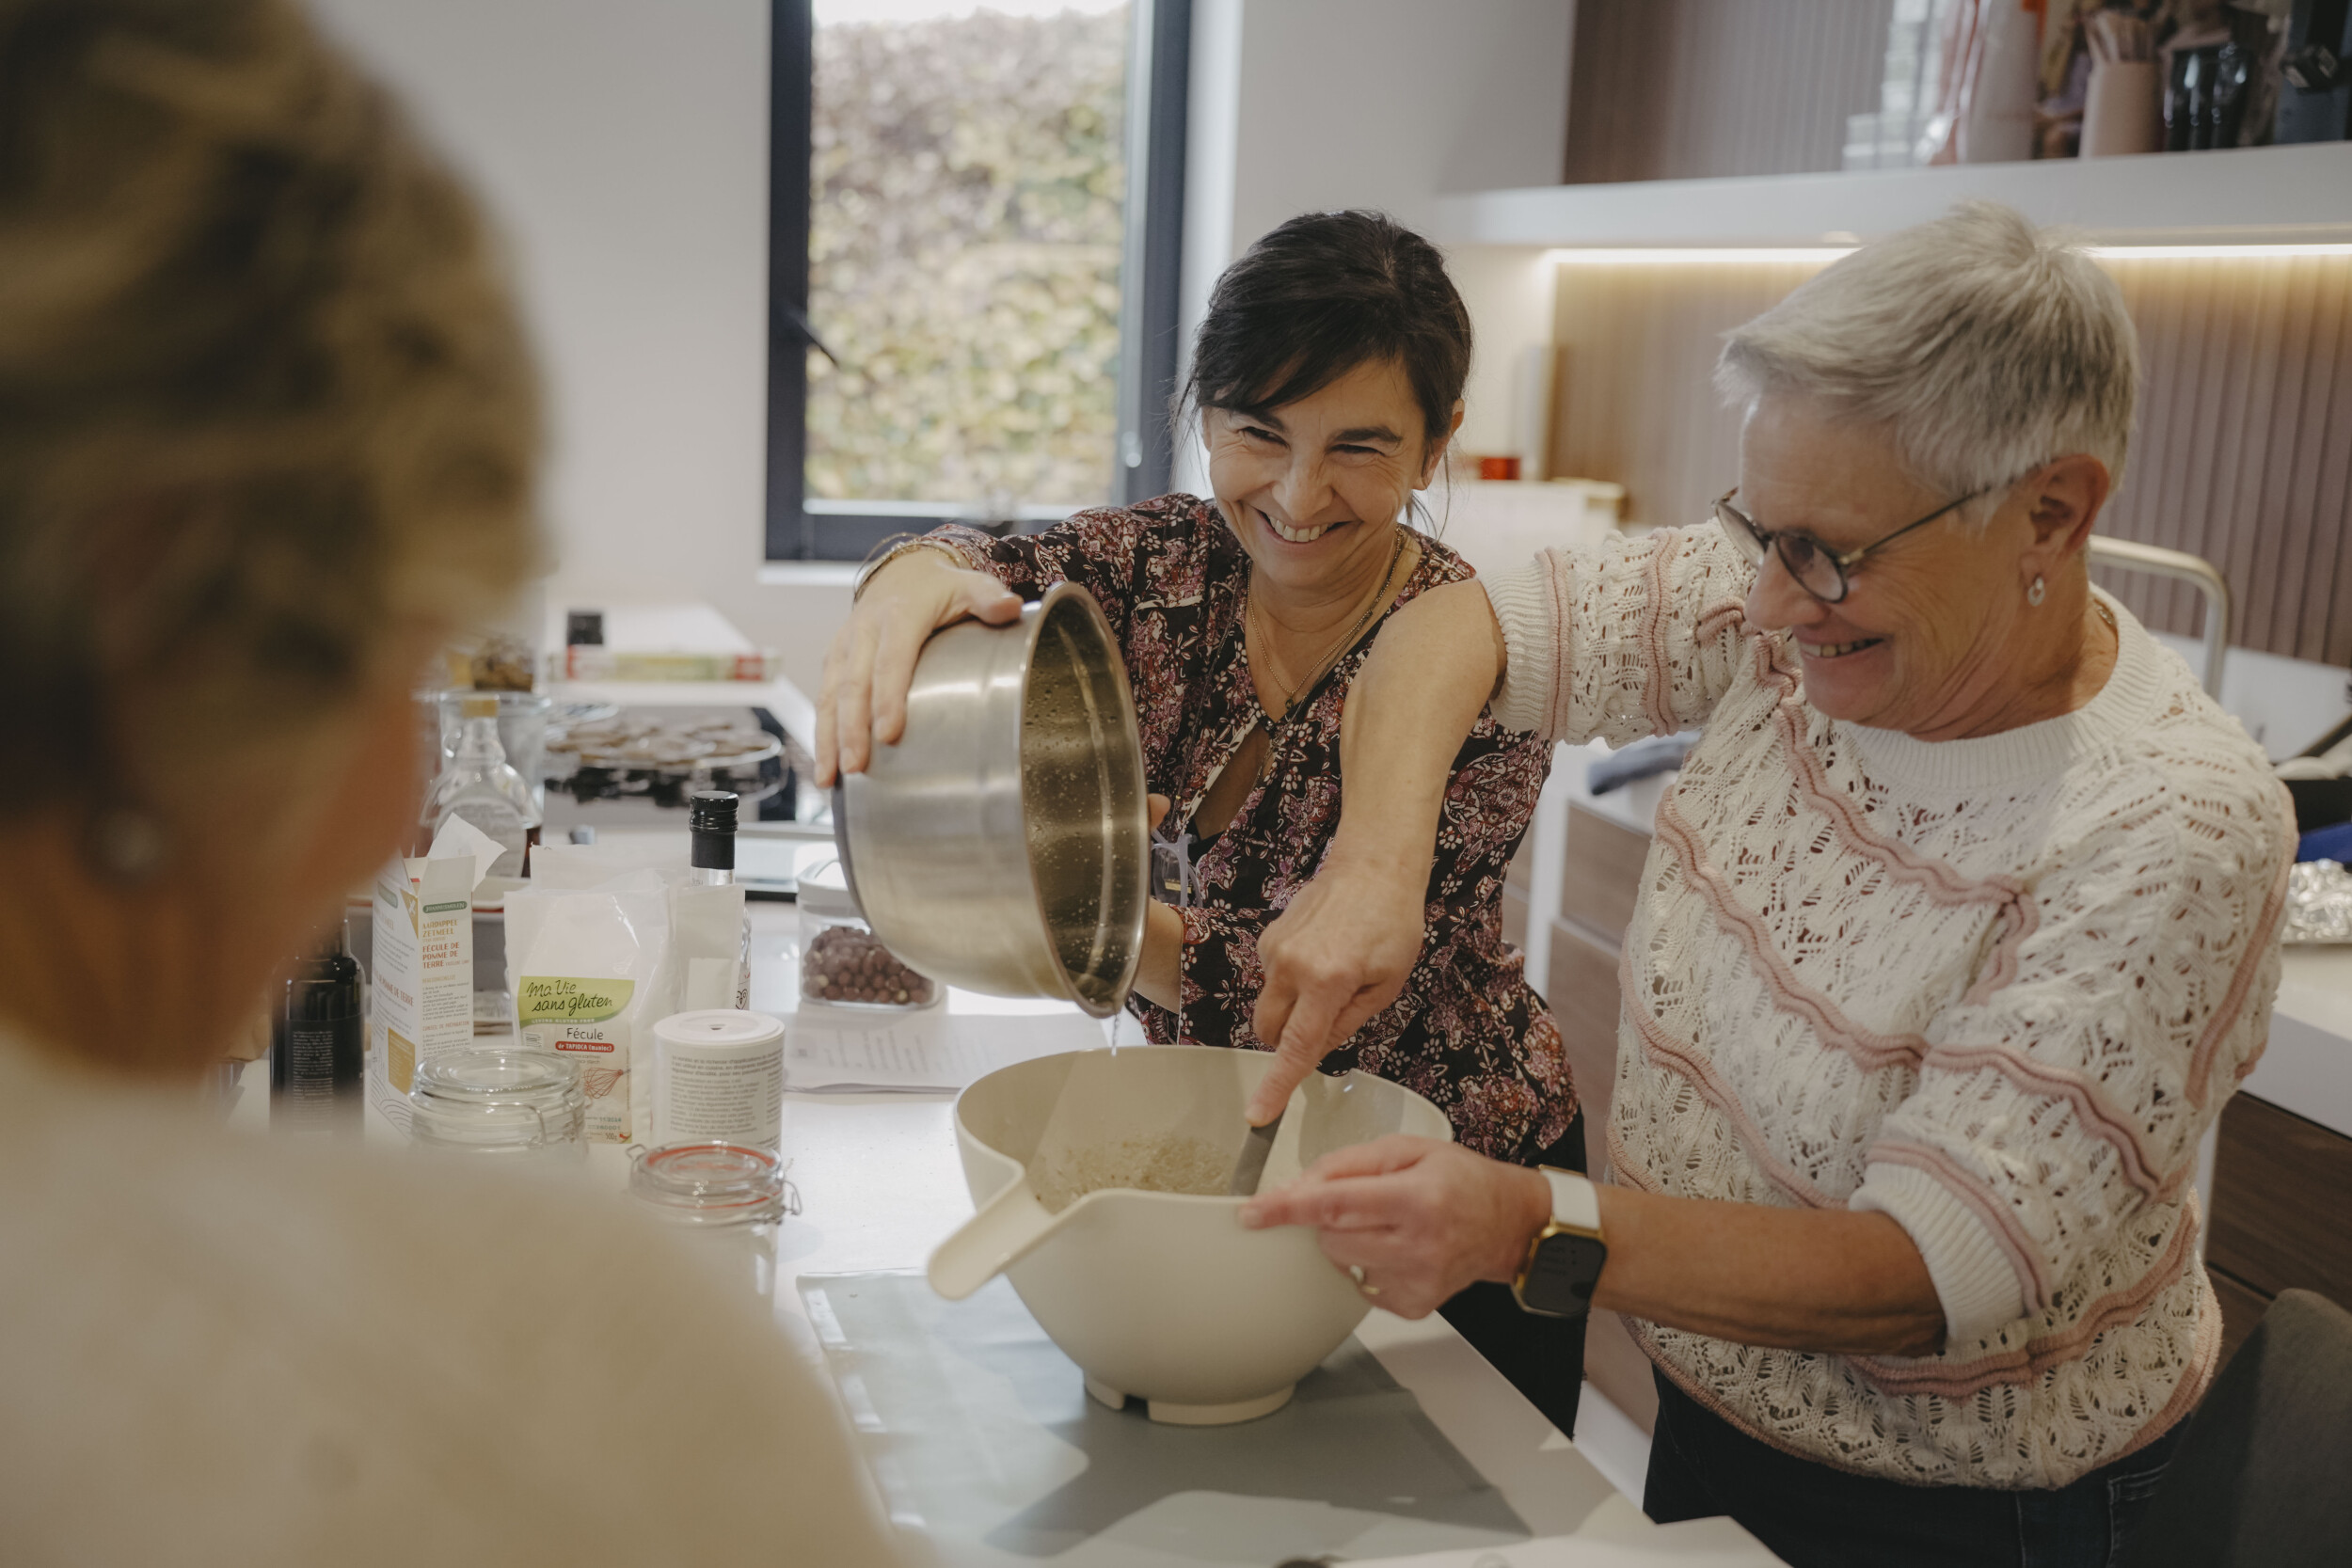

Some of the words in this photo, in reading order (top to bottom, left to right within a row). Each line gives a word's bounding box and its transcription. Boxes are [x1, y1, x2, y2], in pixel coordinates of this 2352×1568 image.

[422, 927, 454, 938] ZETMEEL
[422, 943, 448, 953] FÉCULE
[422, 952, 448, 960] POMME
[422, 960, 444, 970] TERRE
[527, 982, 551, 997] Ma
[556, 979, 577, 995] Vie
[400, 990, 414, 1006] TERRE
[532, 1000, 564, 1012] sans
[568, 993, 613, 1017] gluten
[566, 1027, 604, 1040] Fécule
[588, 1044, 612, 1053] (manioc)
